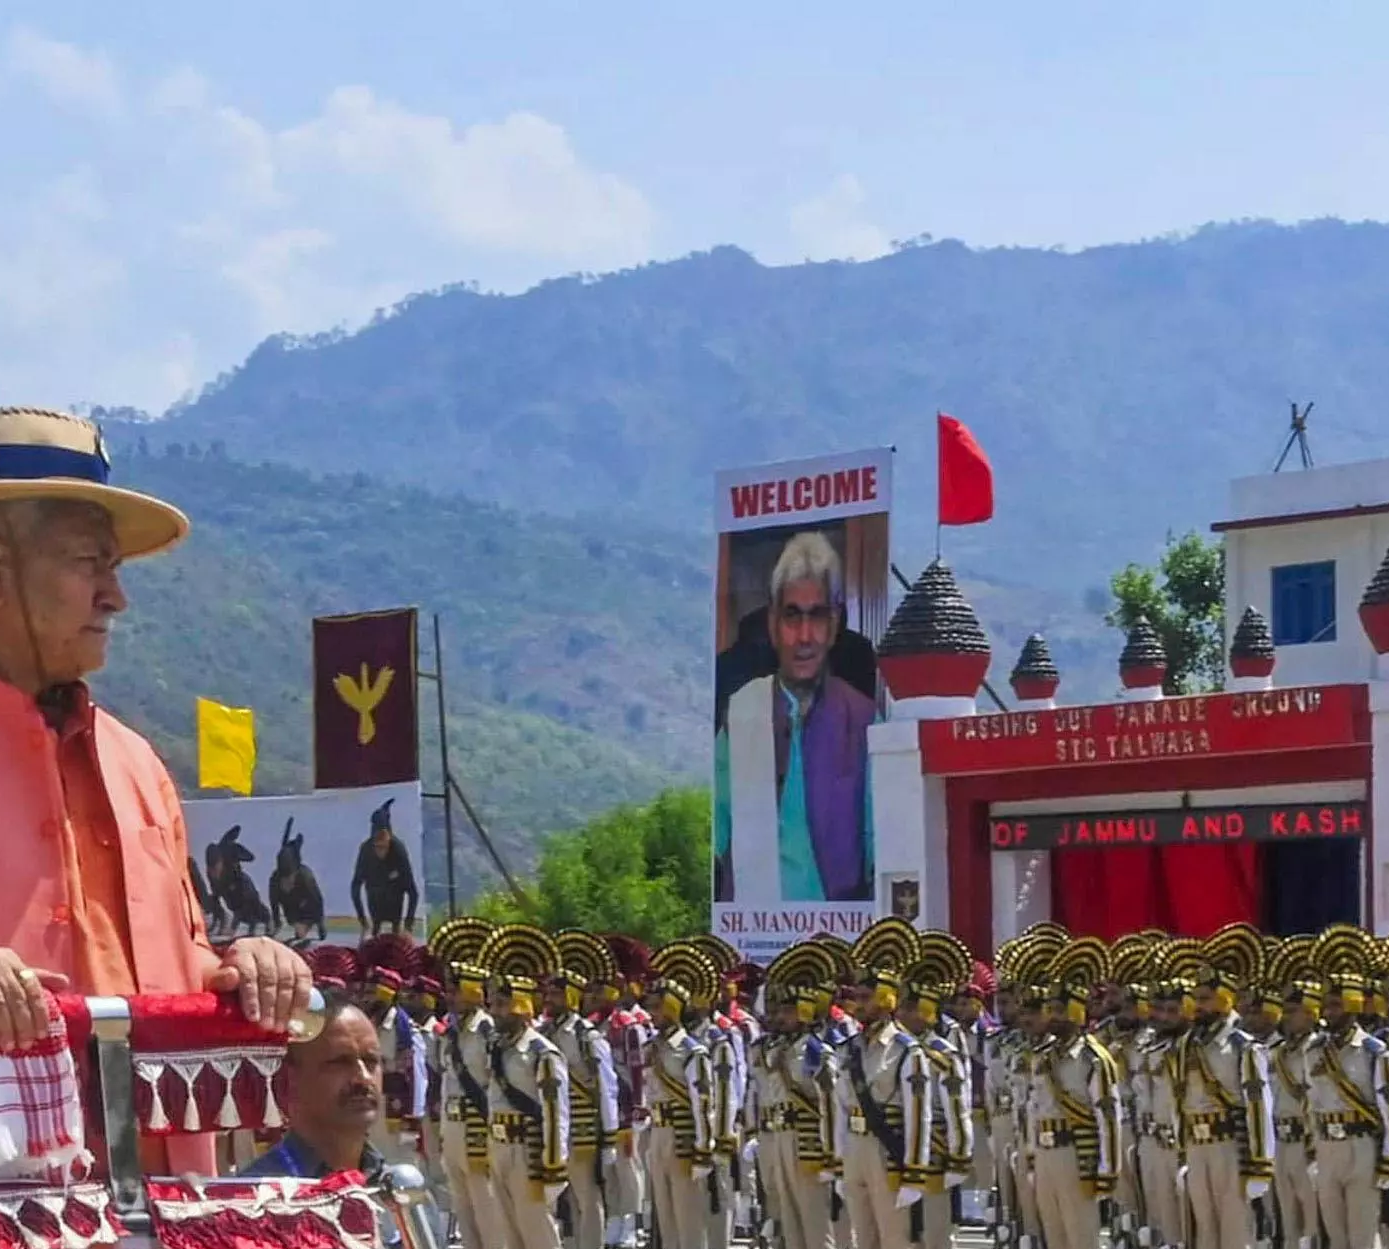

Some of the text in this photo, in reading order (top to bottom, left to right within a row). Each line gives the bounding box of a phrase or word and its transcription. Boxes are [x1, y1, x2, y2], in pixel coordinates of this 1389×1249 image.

[731, 466, 877, 518] WELCOME
[1115, 698, 1206, 728] PARADE
[1056, 729, 1211, 761] STC TALWARA
[994, 808, 1362, 847] OF JAMMU AND KASH
[720, 911, 748, 933] SH.
[753, 911, 816, 934] MANOJ
